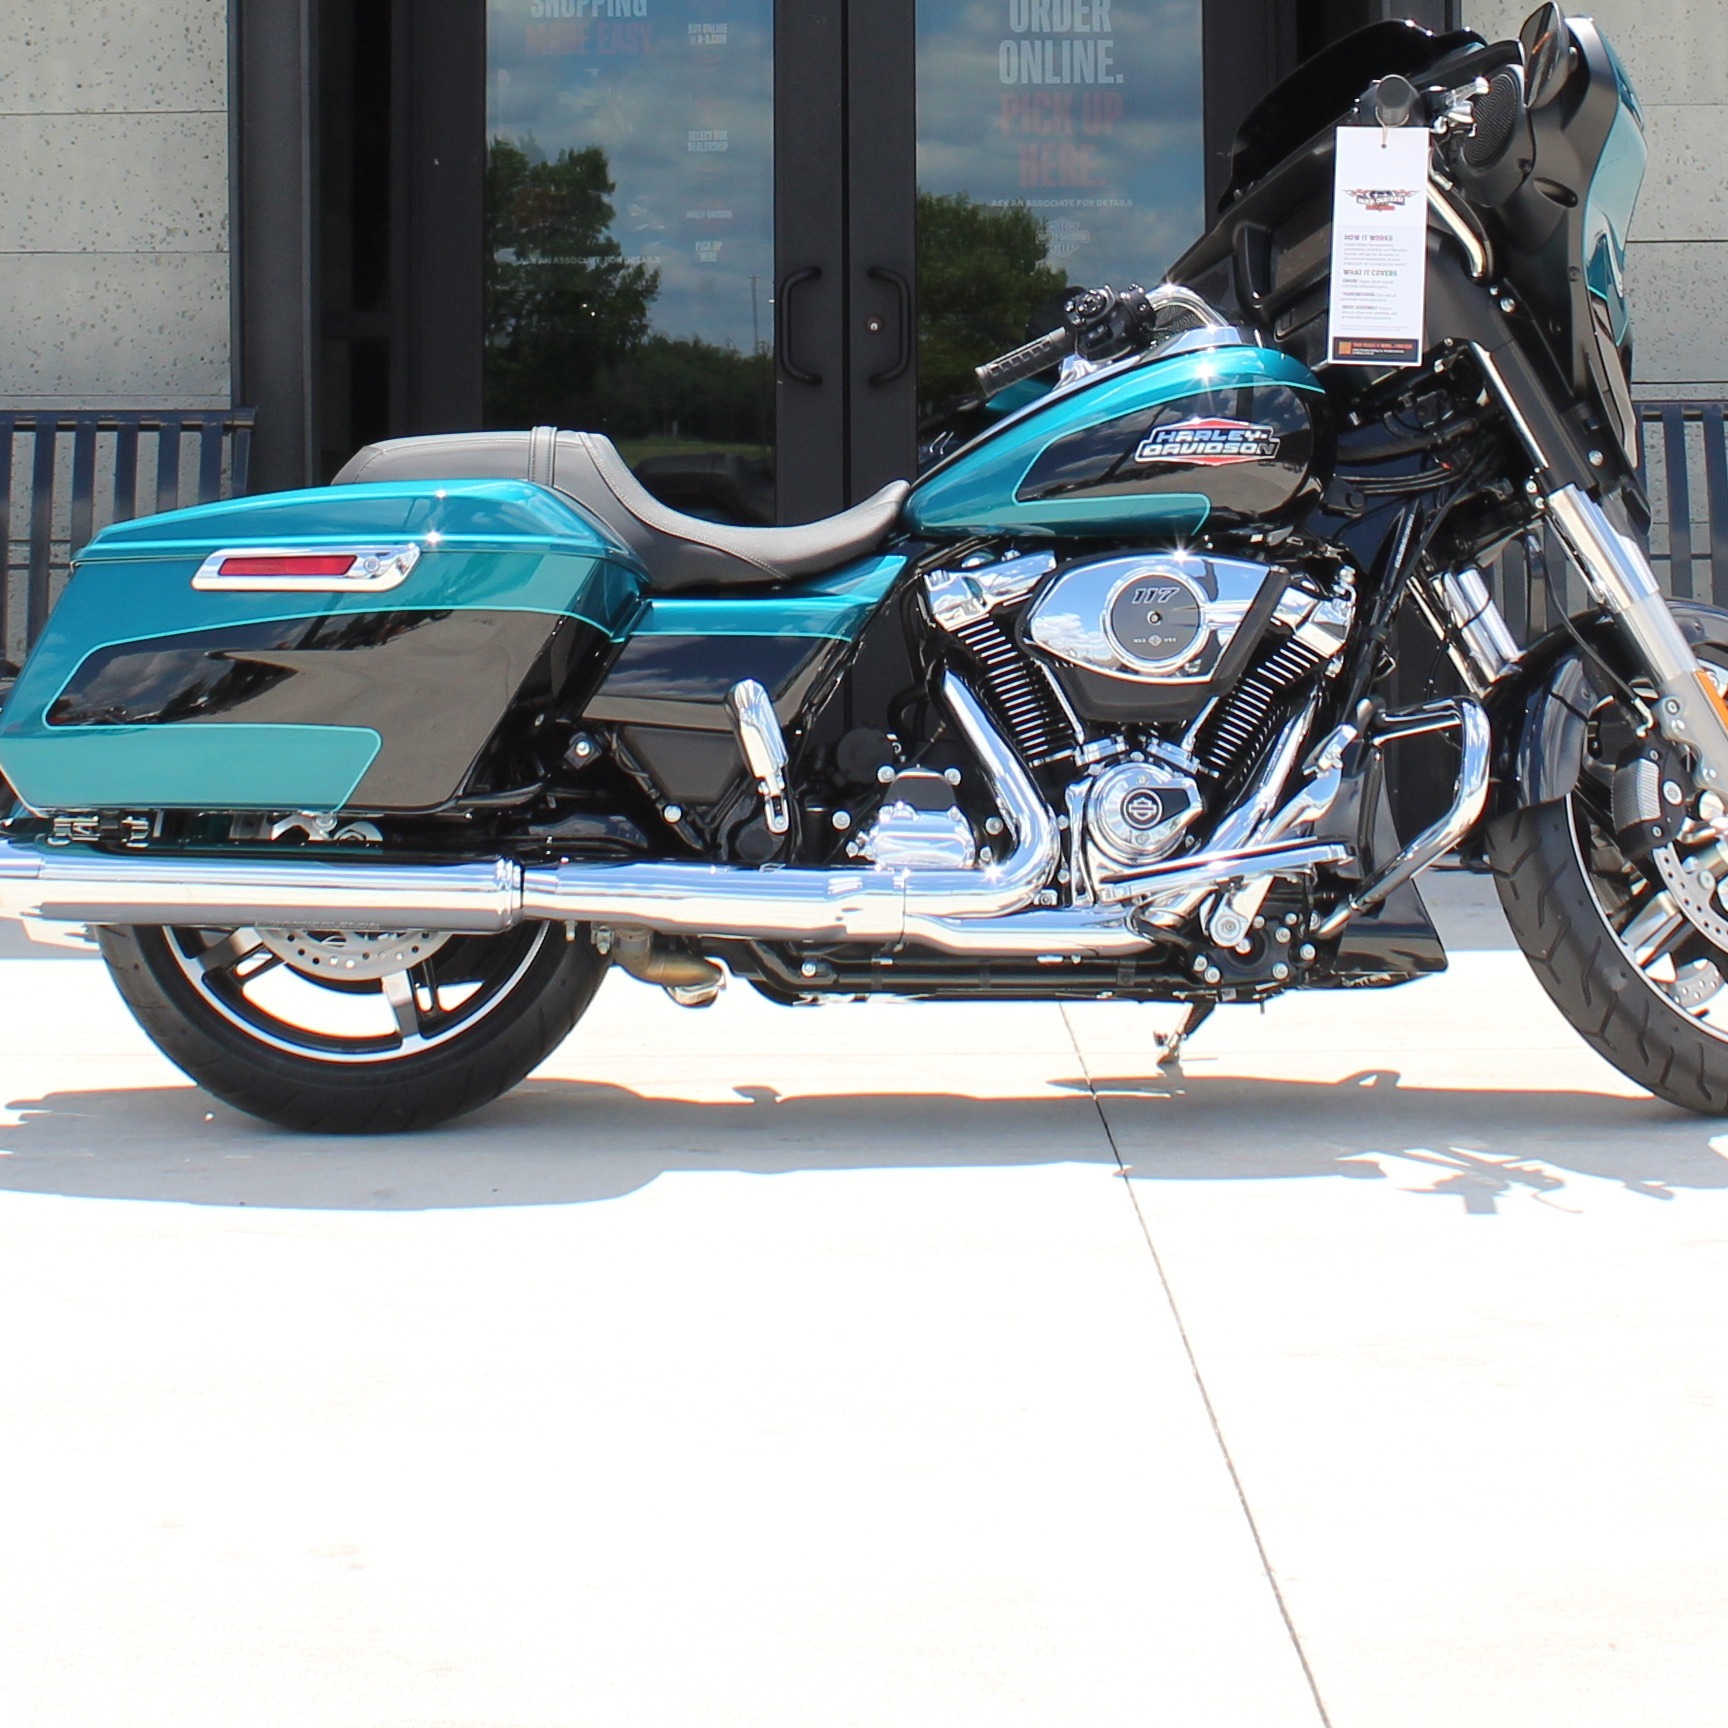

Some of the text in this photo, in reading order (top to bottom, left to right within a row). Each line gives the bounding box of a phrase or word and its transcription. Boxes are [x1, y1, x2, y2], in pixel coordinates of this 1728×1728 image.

[999, 39, 1124, 84] ONLINE.
[1000, 91, 1123, 136] PICK UP
[1019, 143, 1106, 188] HERE.
[1026, 199, 1073, 207] ASSOCIATE
[1076, 199, 1094, 207] FOR
[1096, 199, 1133, 207] DETAILS
[1155, 429, 1268, 443] HARLEY-
[1142, 442, 1275, 456] DAVIDSON
[1131, 587, 1180, 604] 117
